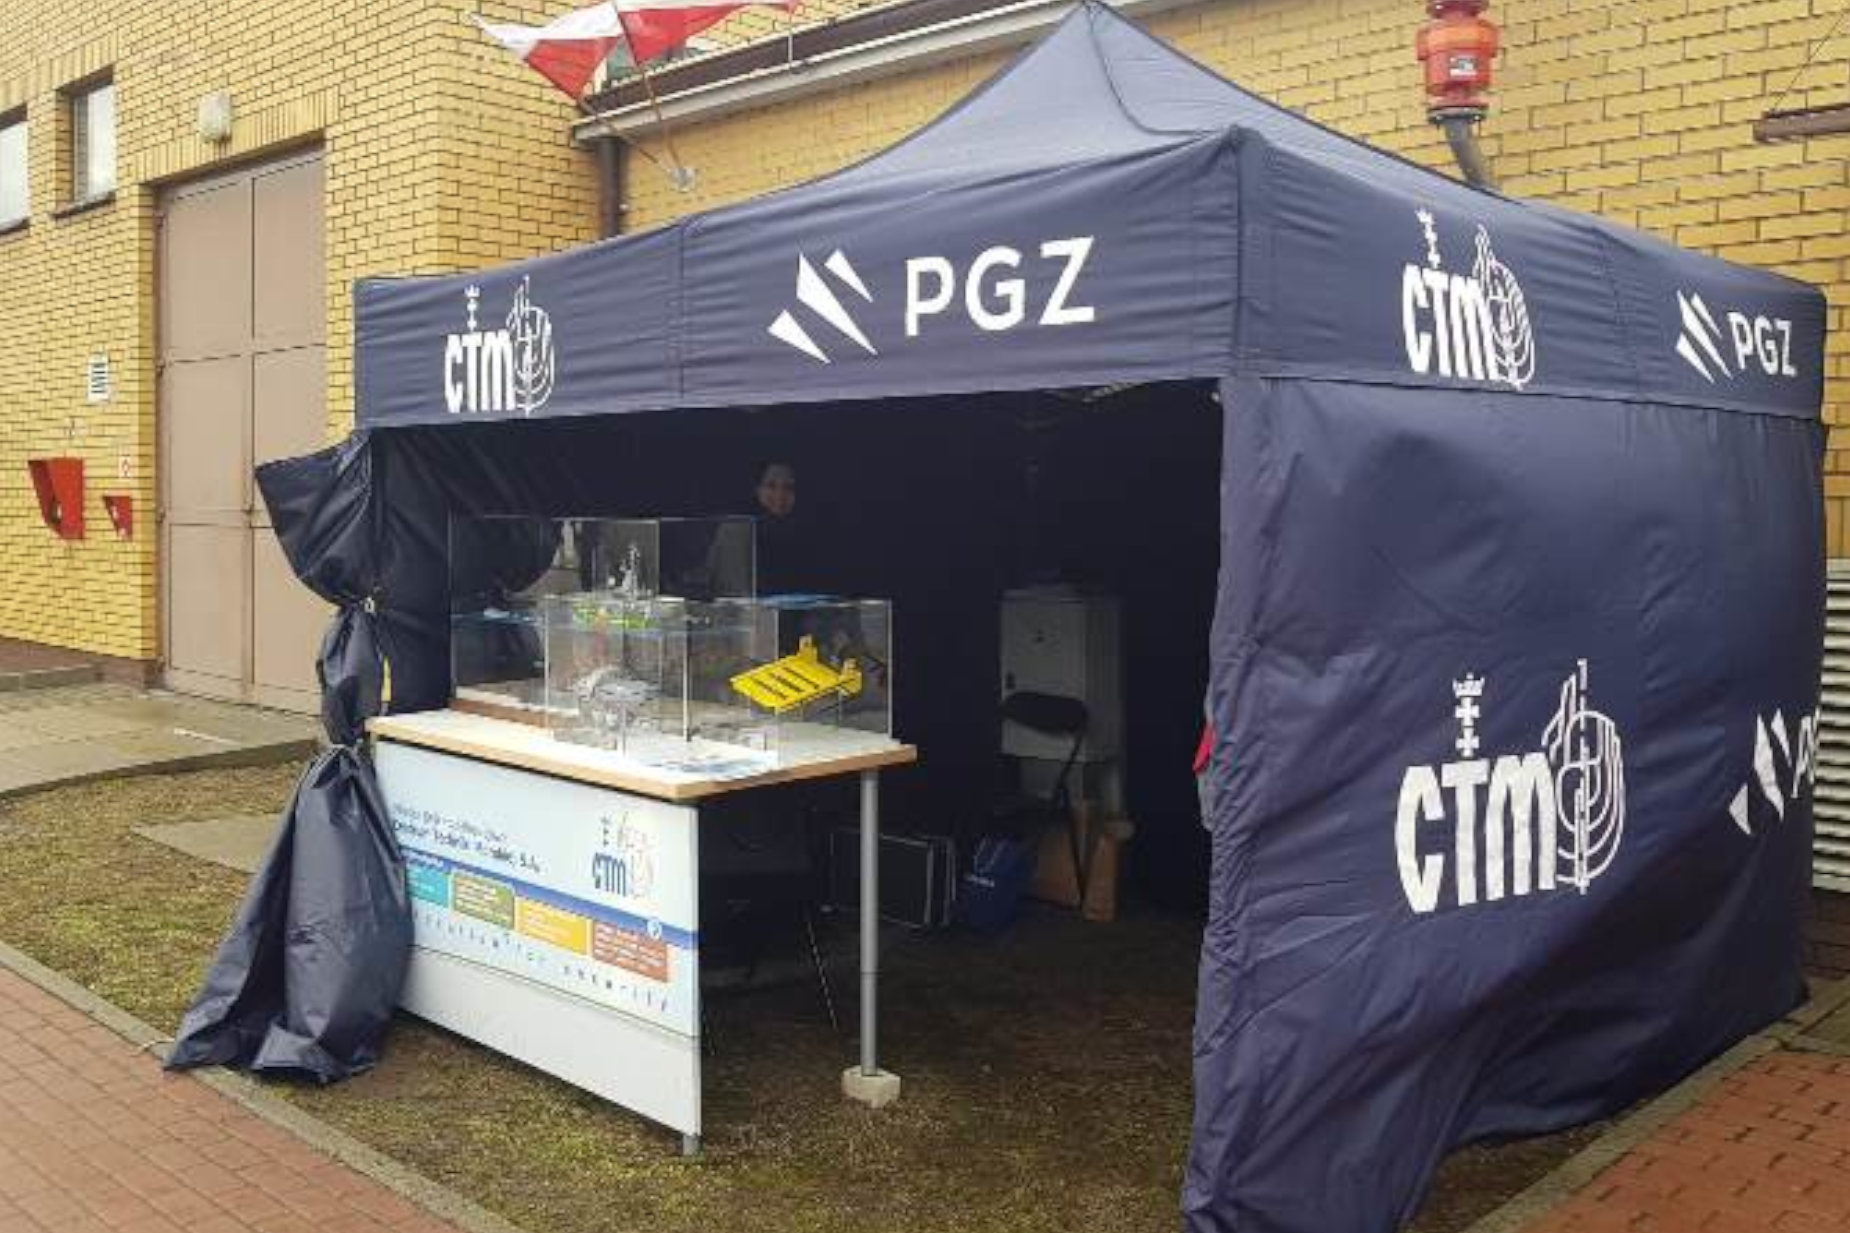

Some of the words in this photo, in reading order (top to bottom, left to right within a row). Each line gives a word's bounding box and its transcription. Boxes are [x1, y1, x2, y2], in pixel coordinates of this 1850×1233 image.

[905, 235, 1094, 336] PGZ
[1403, 263, 1499, 380] CTM
[445, 329, 515, 413] CTM
[1727, 311, 1797, 376] PGZ
[1395, 752, 1556, 914] CTM
